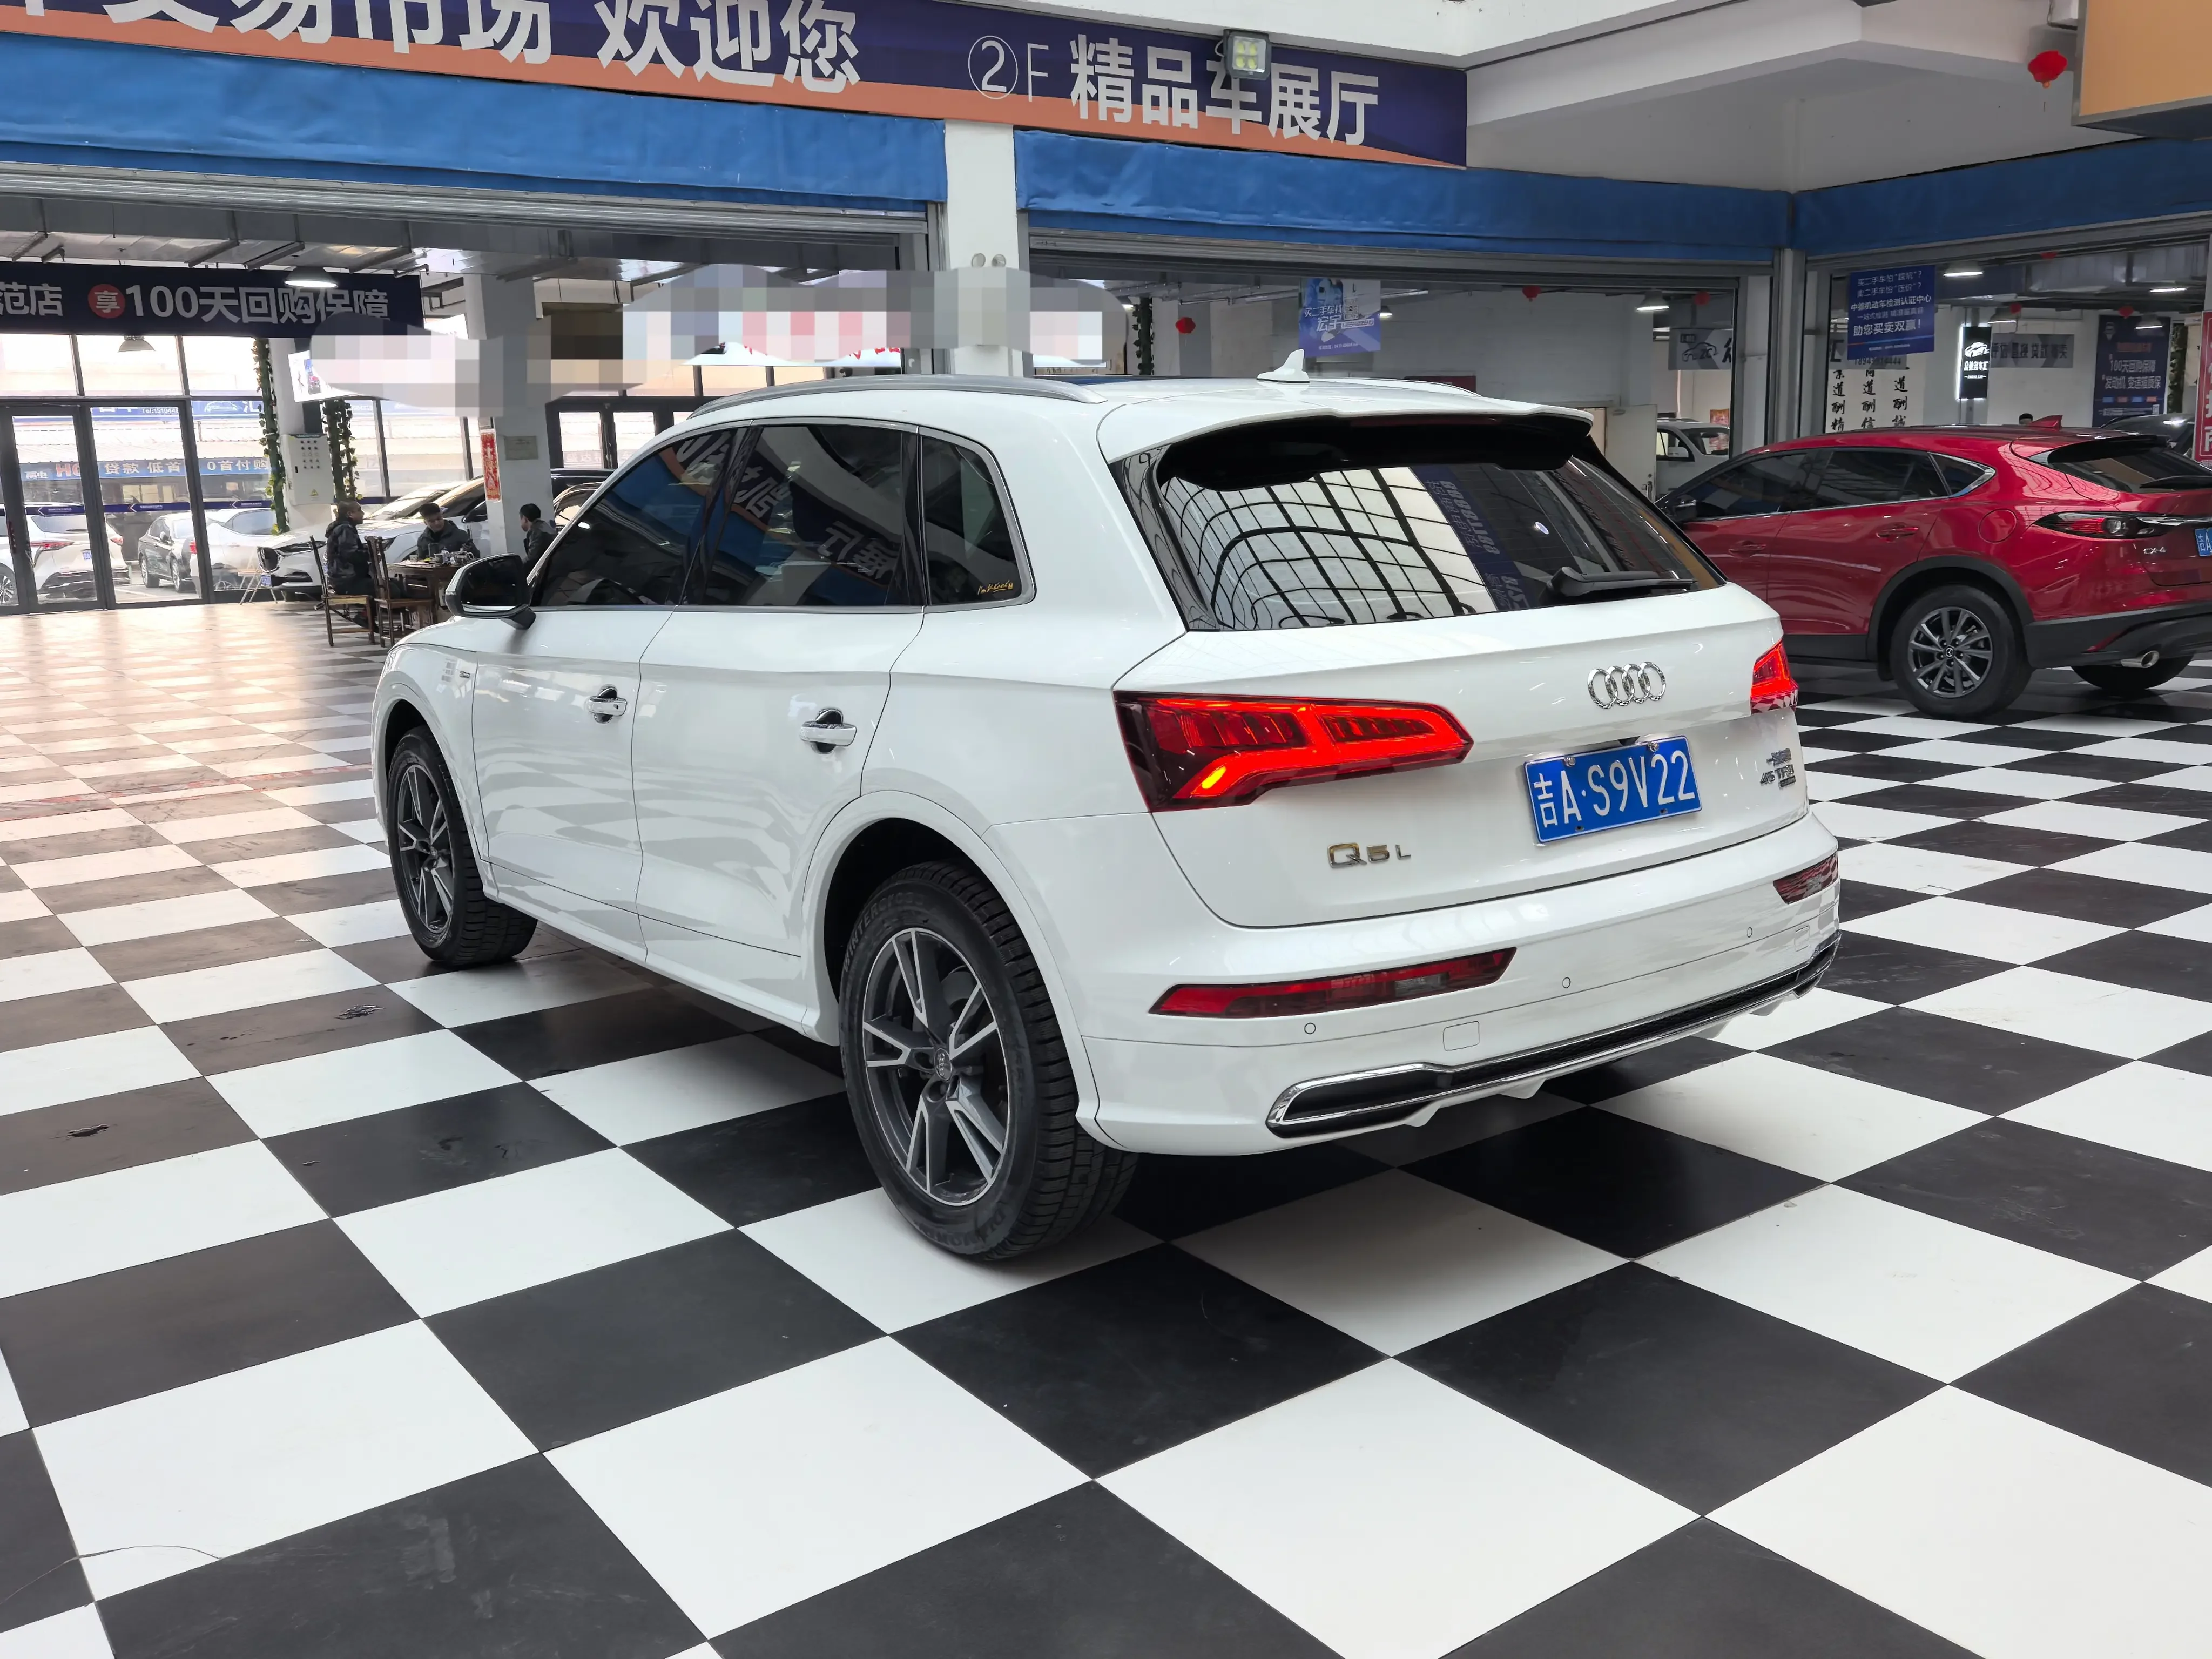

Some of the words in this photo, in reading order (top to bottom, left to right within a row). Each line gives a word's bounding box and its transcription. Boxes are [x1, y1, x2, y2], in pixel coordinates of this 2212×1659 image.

[595, 0, 861, 93] 欢迎您
[1070, 34, 1379, 146] 精品车展厅
[94, 291, 120, 313] 享
[126, 285, 390, 324] 100天回购保障
[104, 462, 140, 474] 贷款
